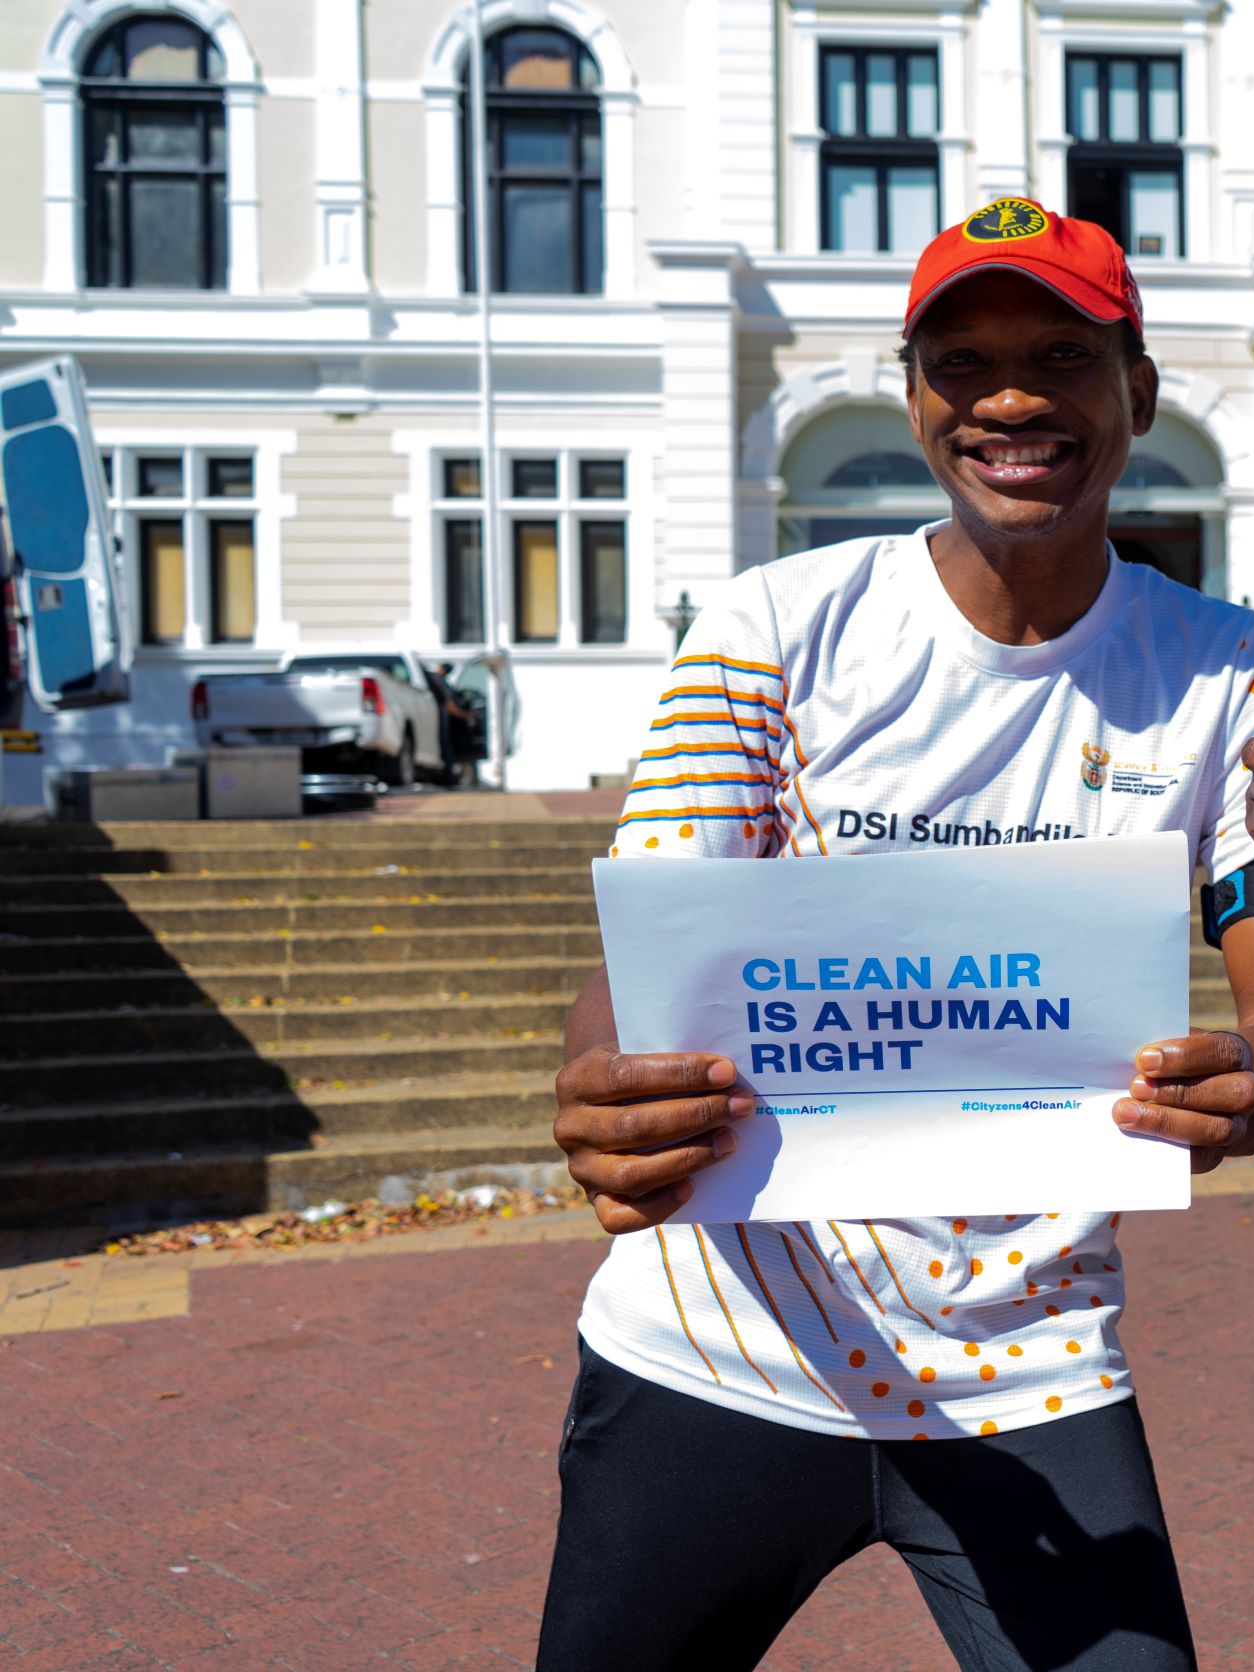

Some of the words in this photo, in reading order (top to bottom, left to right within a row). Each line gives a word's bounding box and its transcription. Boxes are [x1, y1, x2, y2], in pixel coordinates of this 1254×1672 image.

[836, 809, 897, 840] DSI
[909, 814, 1087, 847] Sumbandil
[742, 957, 932, 991] CLEAN
[946, 953, 1041, 989] AIR
[746, 1001, 798, 1033] IS
[813, 1000, 852, 1032] A
[867, 997, 1070, 1031] HUMAN
[751, 1040, 923, 1074] RIGHT
[755, 1104, 837, 1115] #CleanAirCT
[961, 1100, 1082, 1112] #Cityzens4CleanAir
